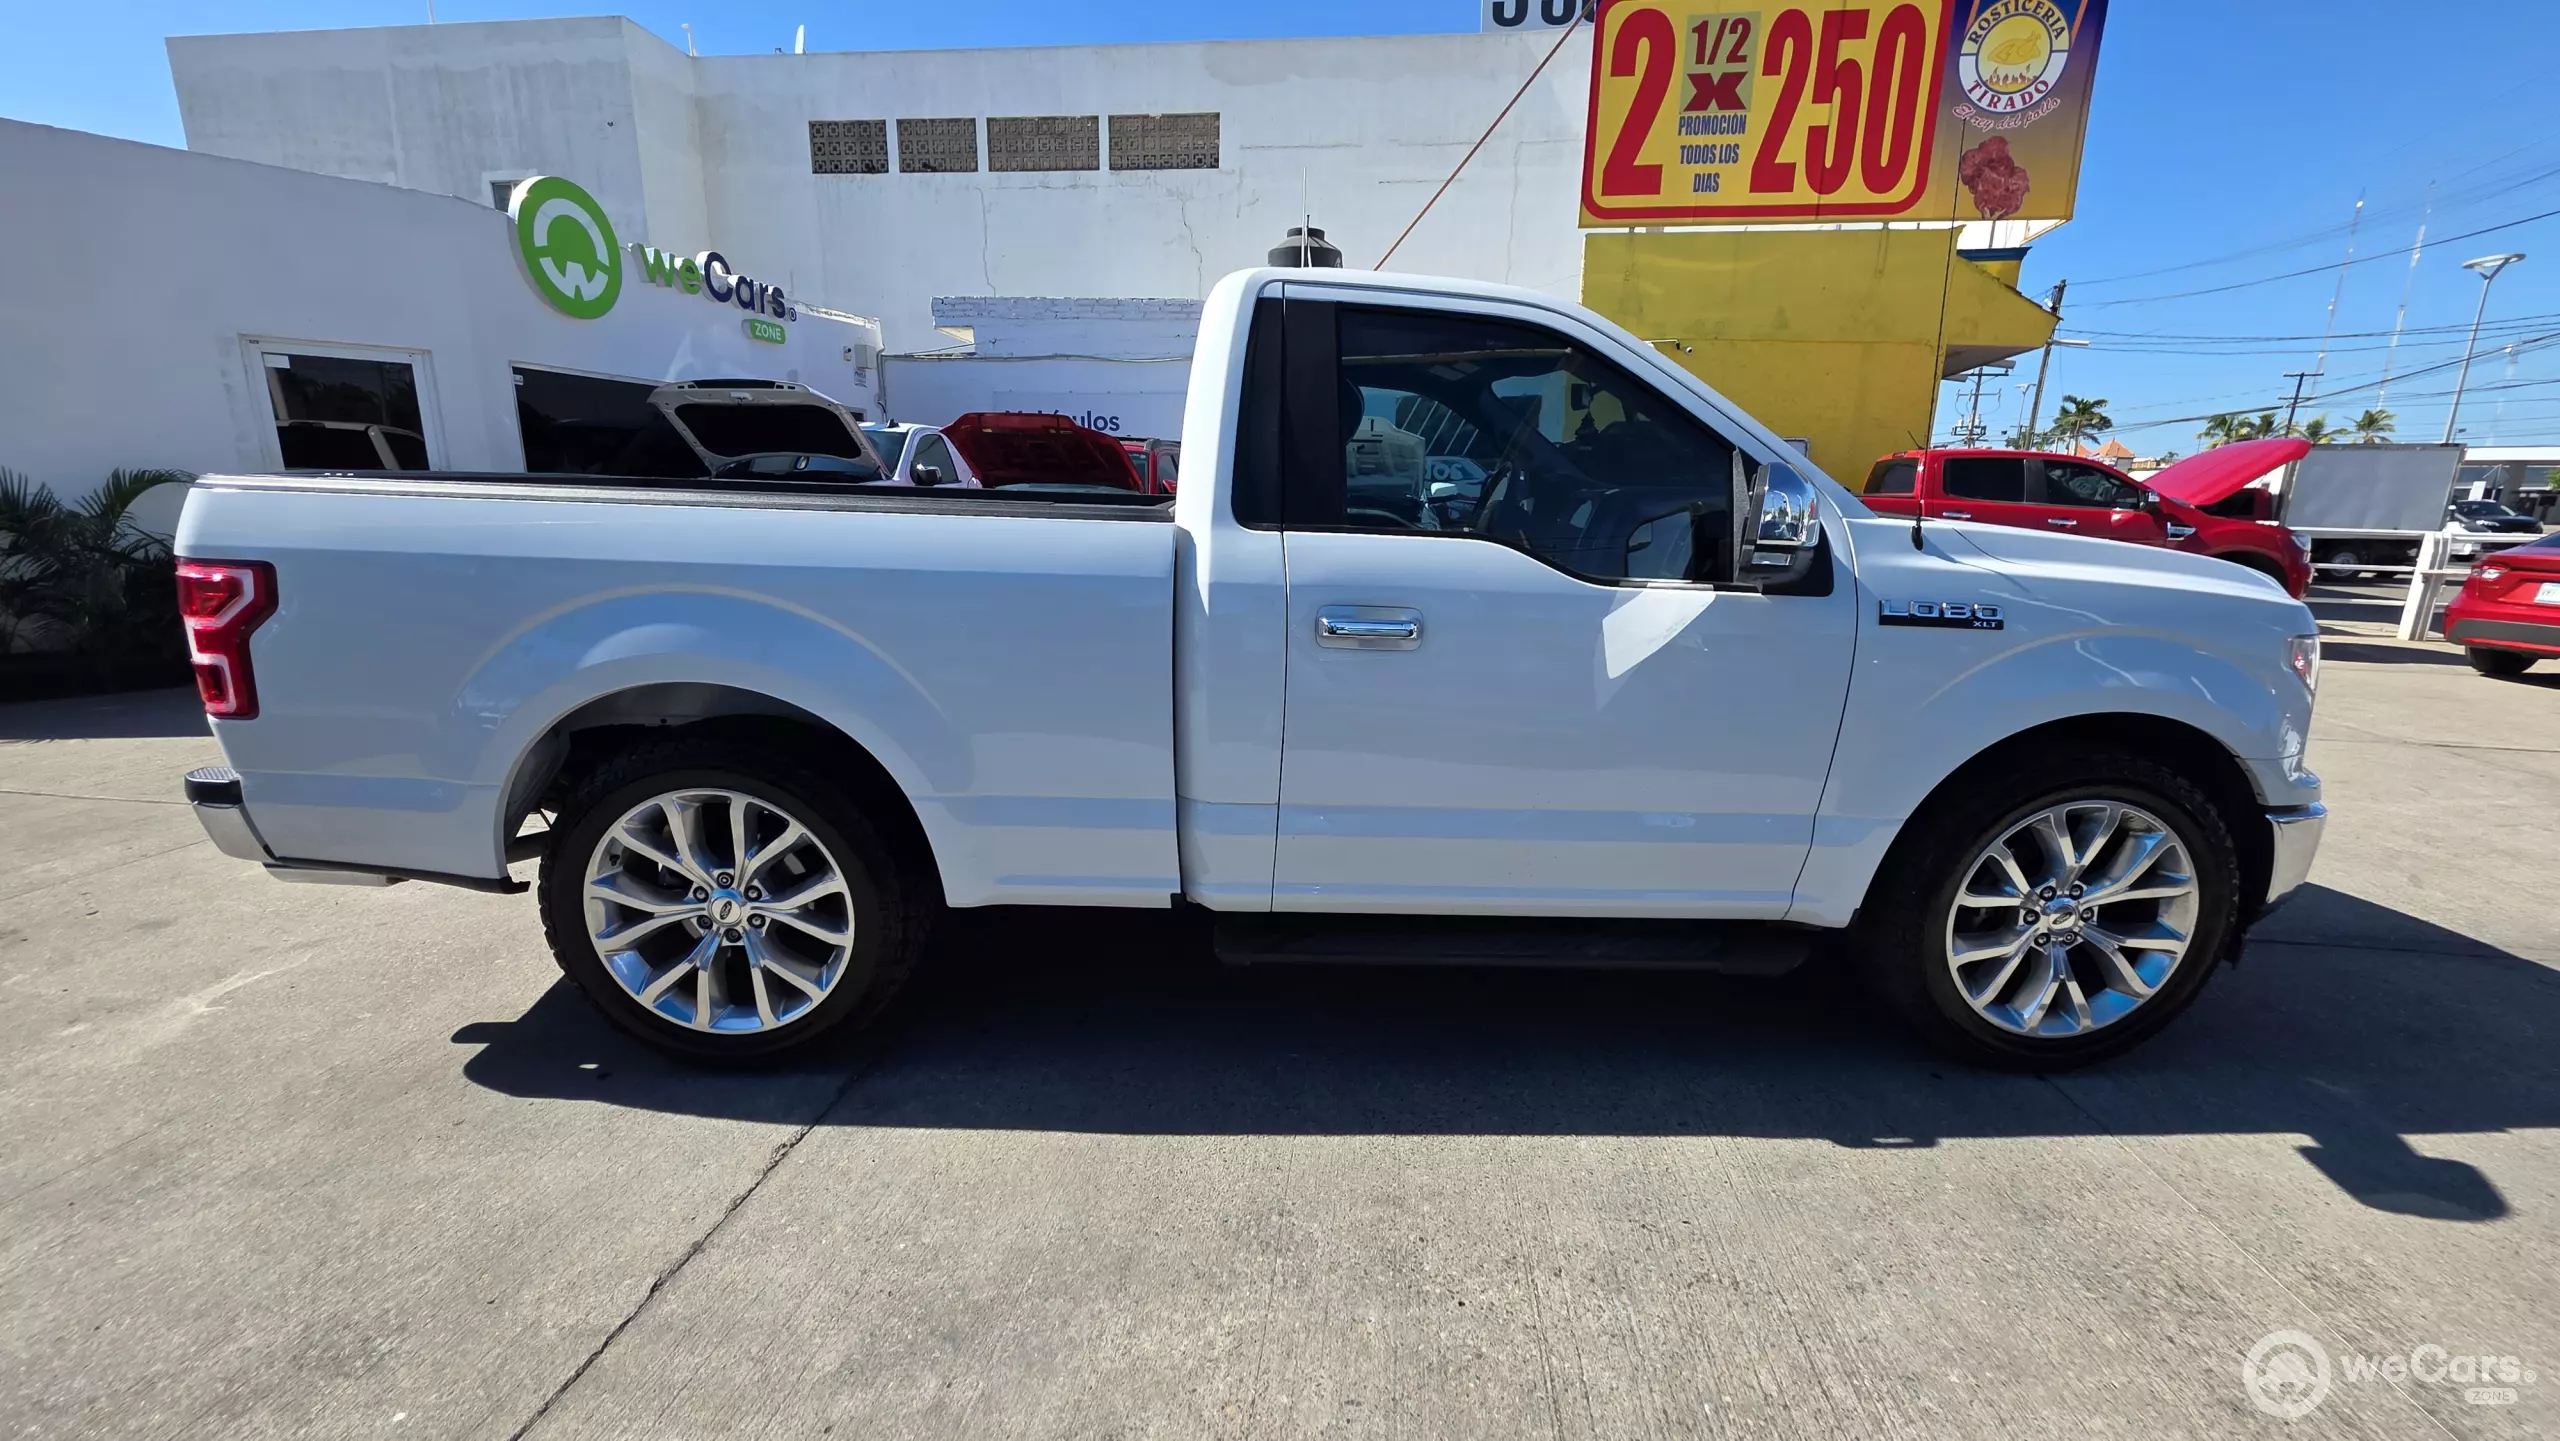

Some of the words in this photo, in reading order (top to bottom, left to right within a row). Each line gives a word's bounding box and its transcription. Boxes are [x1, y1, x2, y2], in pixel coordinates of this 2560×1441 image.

[1967, 0, 2067, 45] ROSTICERIA
[1601, 7, 1676, 197] 2
[1691, 17, 1752, 66] 1/2
[1748, 3, 1927, 195] 250
[1967, 79, 2049, 110] TIRADO
[1971, 117, 1995, 133] rey
[1997, 112, 2022, 130] del
[2024, 98, 2061, 129] pollo
[1680, 144, 1717, 165] TODOS
[1718, 143, 1740, 164] LOS
[1692, 172, 1720, 193] DIAS
[754, 323, 782, 341] ZONE
[1879, 599, 2004, 621] LOBO
[1972, 620, 1998, 628] XLT
